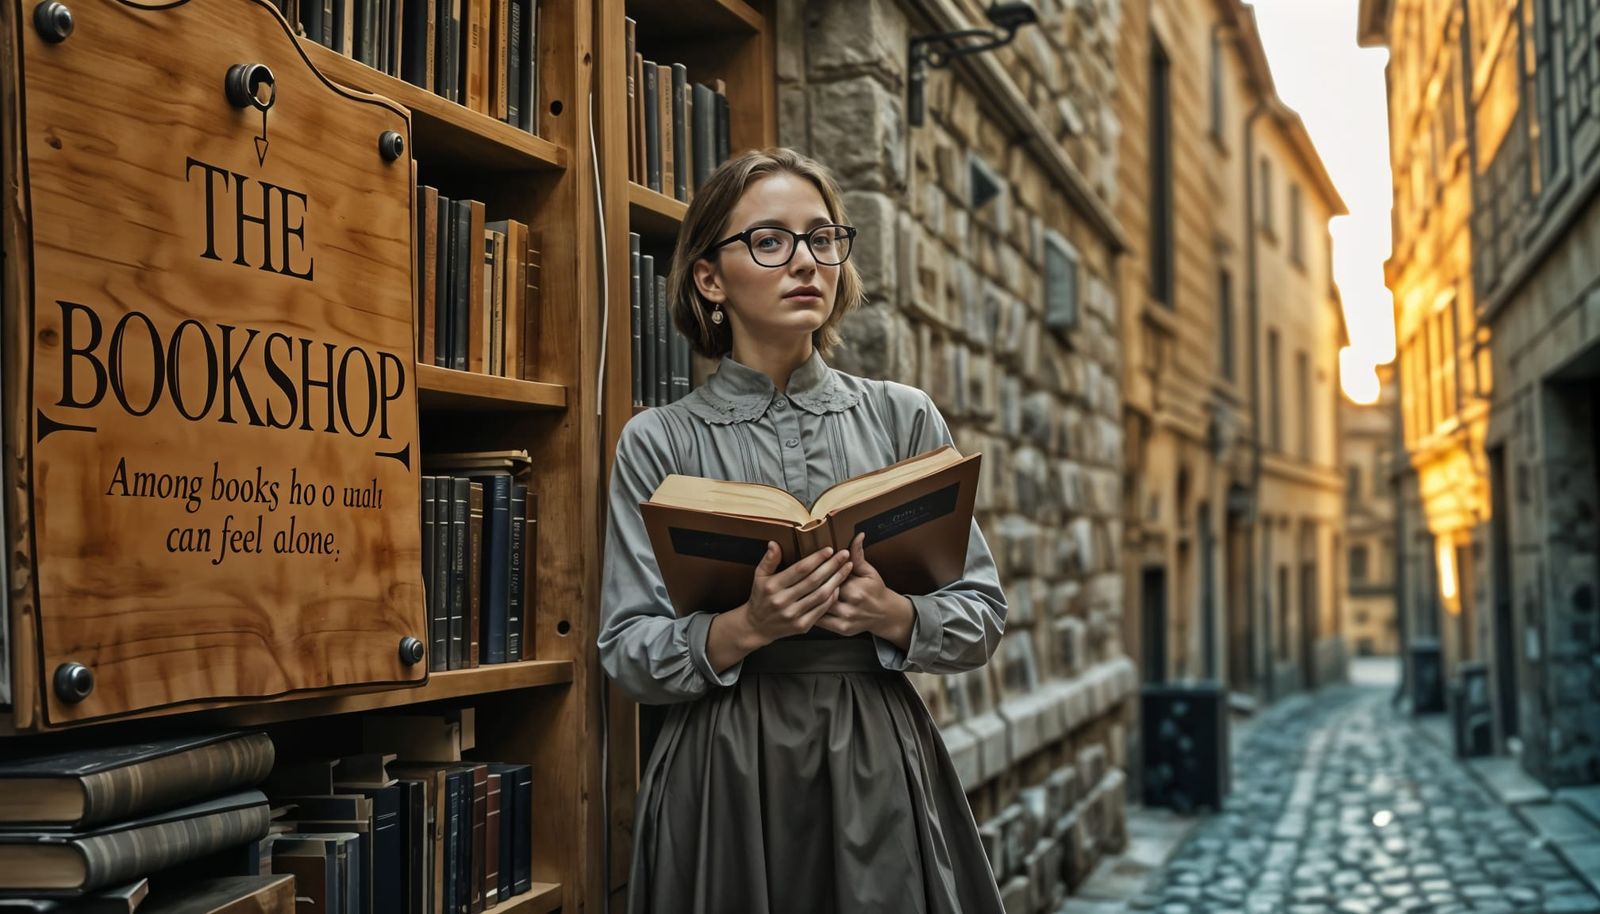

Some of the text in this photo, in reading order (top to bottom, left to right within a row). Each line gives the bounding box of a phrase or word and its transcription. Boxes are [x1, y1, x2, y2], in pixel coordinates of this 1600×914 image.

[186, 157, 313, 281] THE
[55, 300, 405, 440] BOOKSHOP
[106, 457, 203, 513] Among
[211, 462, 280, 512] books
[166, 526, 211, 553] can
[212, 514, 263, 566] feel
